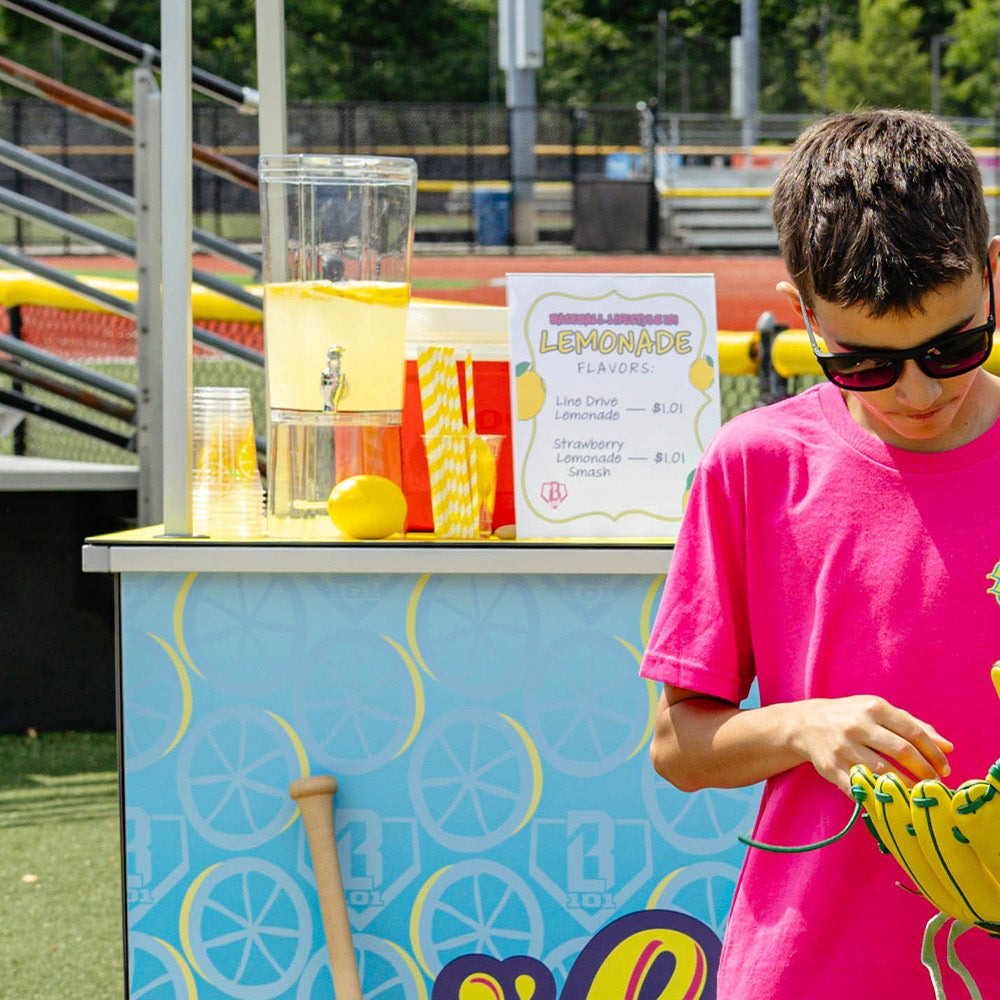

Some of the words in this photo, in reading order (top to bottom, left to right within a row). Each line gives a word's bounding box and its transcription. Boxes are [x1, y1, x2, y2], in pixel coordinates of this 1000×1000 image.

[540, 329, 692, 356] LEMONADE
[577, 361, 655, 374] FLAVORS:
[556, 396, 582, 407] Line
[586, 395, 618, 407] Drive
[555, 409, 620, 421] Lemonade
[651, 403, 683, 415] $1.01
[553, 438, 624, 451] Strawberry
[556, 451, 622, 464] Lemonade
[654, 452, 686, 464] $1.01
[568, 466, 611, 478] Smash
[567, 893, 616, 908] 101
